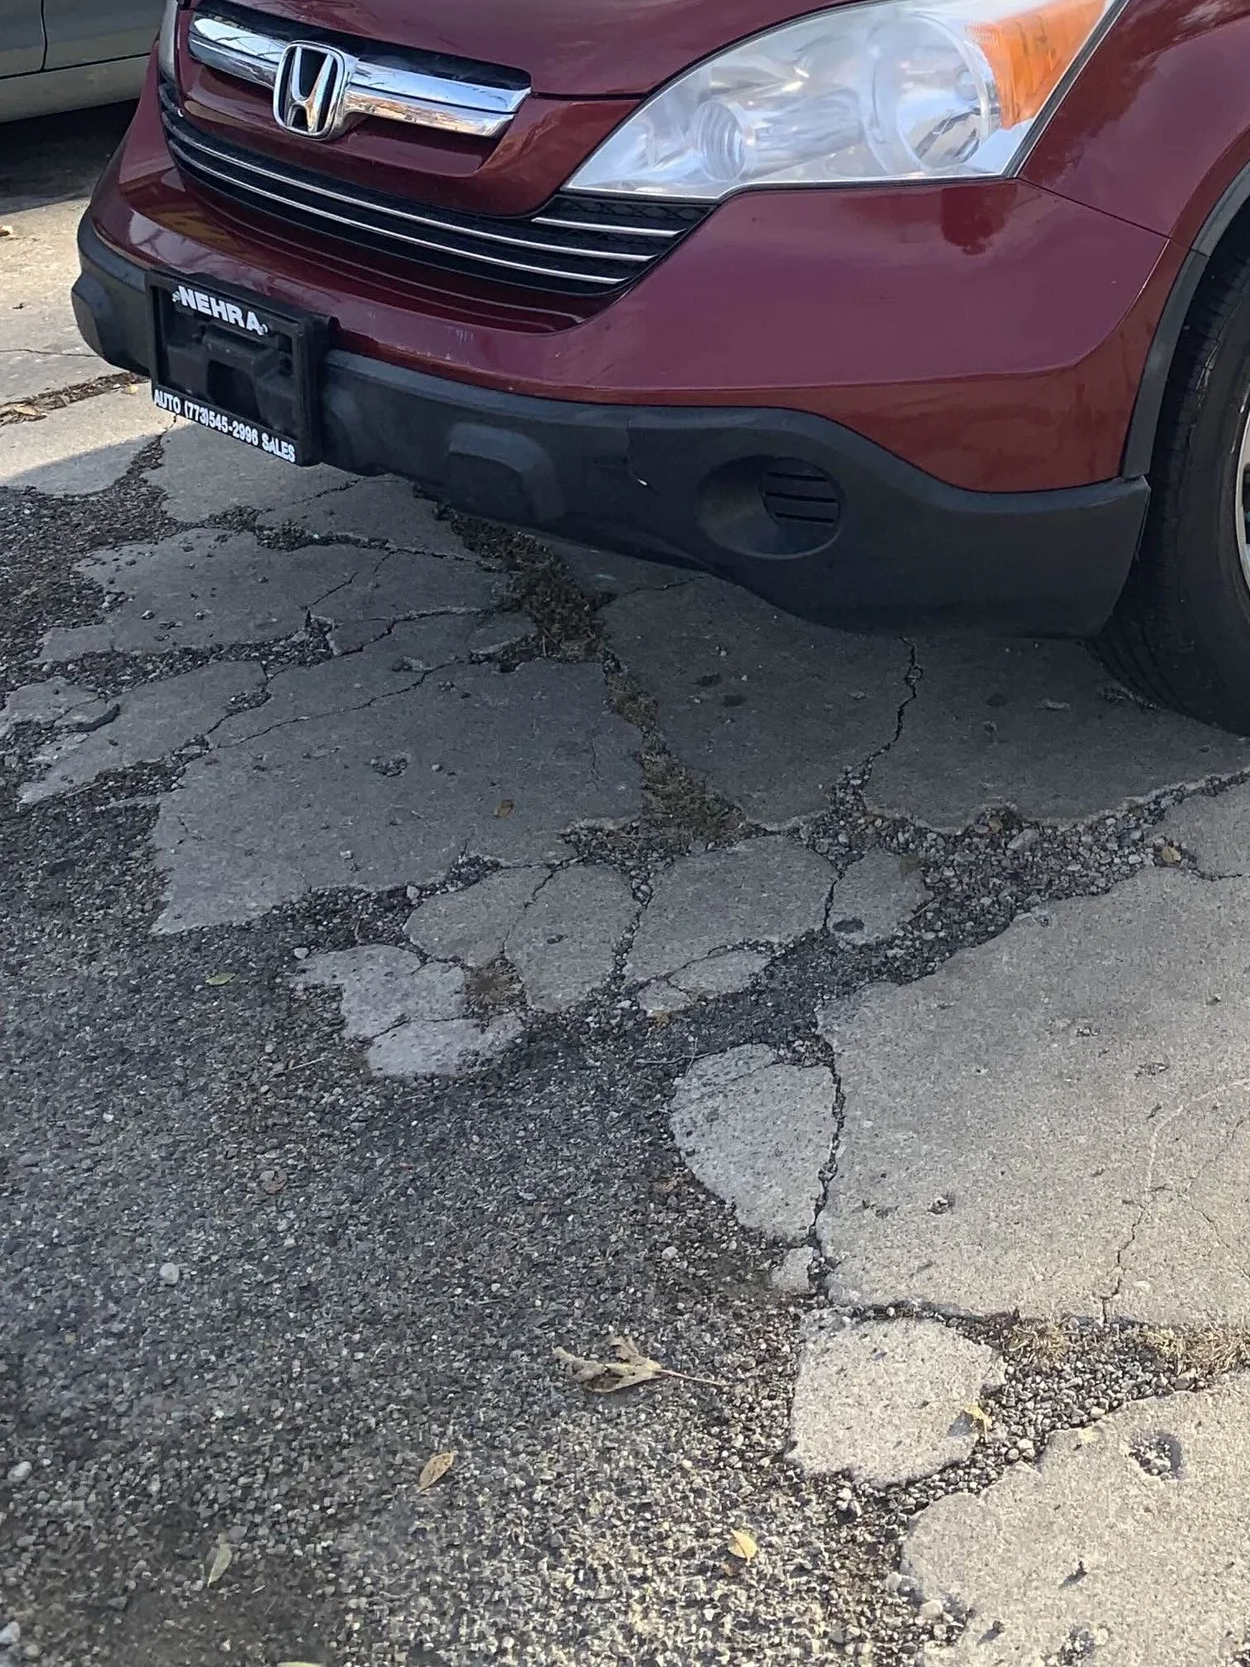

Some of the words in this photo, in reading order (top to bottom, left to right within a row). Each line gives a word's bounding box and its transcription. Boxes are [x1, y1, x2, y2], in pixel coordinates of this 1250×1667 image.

[178, 285, 266, 335] NEHRA
[153, 389, 181, 414] AUTO
[261, 432, 296, 463] SALES
